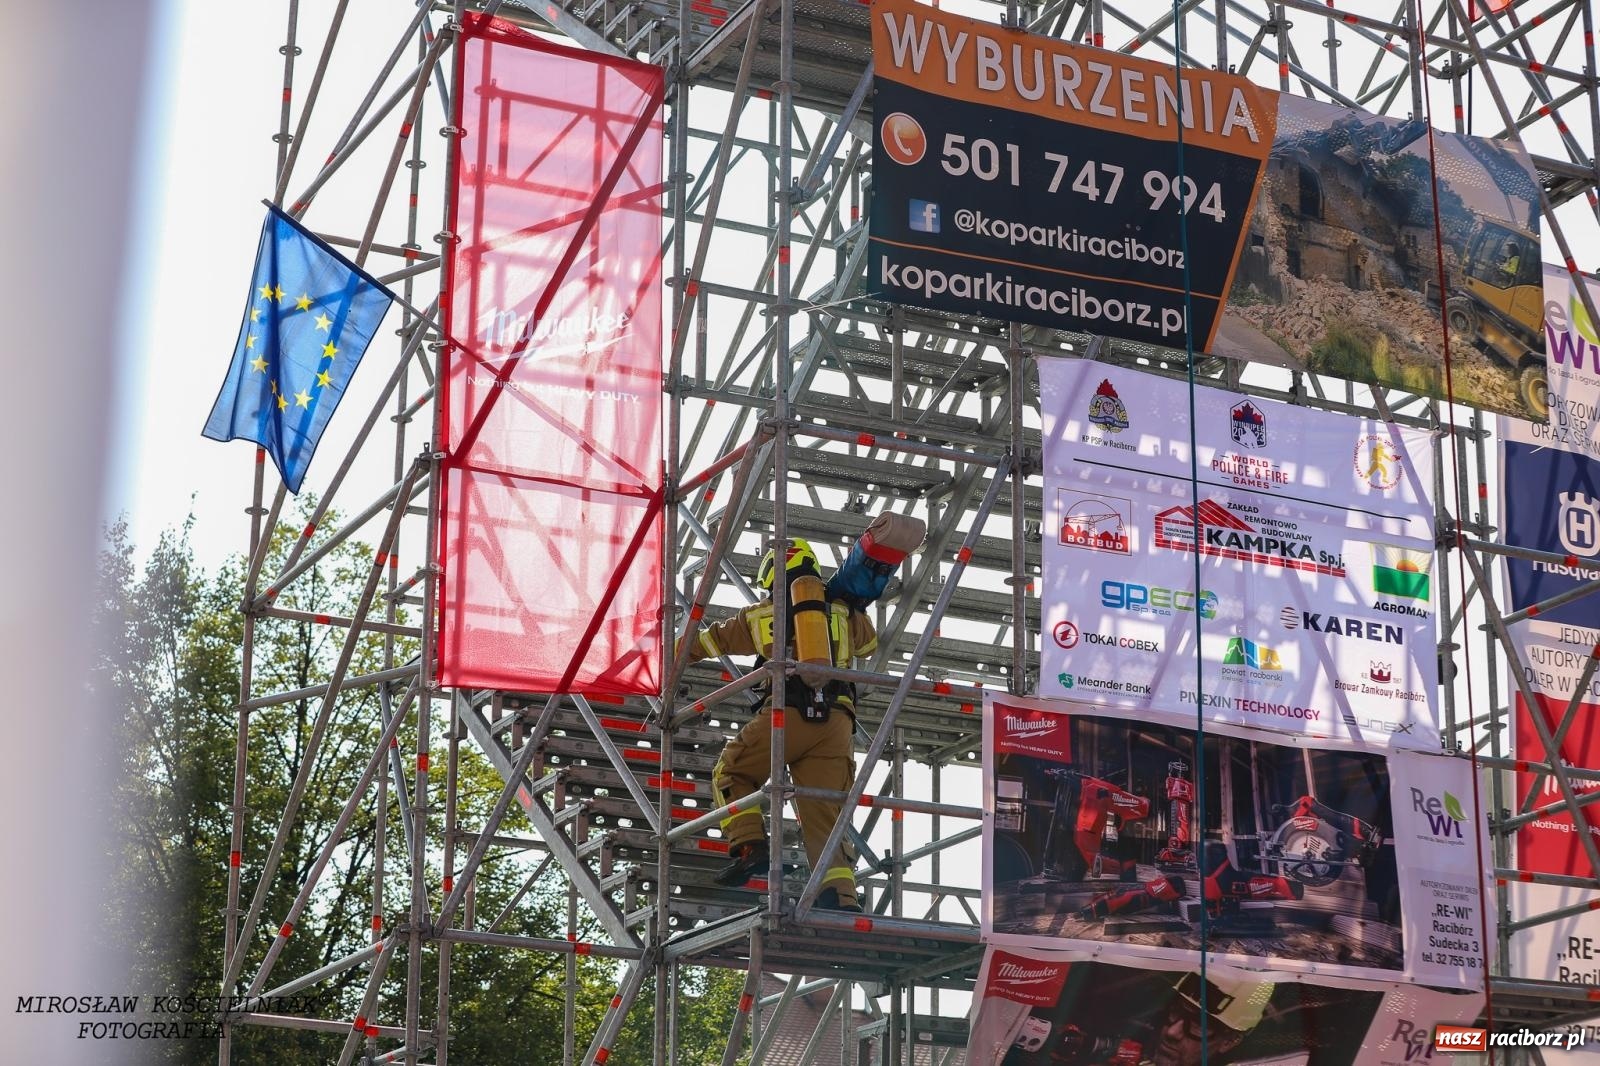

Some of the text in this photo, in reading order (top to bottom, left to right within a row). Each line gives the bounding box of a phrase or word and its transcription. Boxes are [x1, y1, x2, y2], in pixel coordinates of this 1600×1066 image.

[883, 12, 1259, 142] WYBURZENIA
[940, 132, 1226, 223] 501 747 994
[953, 208, 1186, 269] @koparkiraciborz
[881, 255, 1188, 337] koparkiraciborz.pl
[475, 304, 630, 350] Milwaukee
[467, 375, 521, 392] Nothing
[1232, 454, 1269, 468] WORLD
[1212, 459, 1289, 485] POLICE & FIRE
[1233, 476, 1270, 489] GAMES
[1227, 502, 1259, 514] ZAKŁAD
[1244, 515, 1298, 531] REMONTOWO
[1067, 534, 1124, 551] BORBUD
[1206, 527, 1316, 562] KAMPKA
[1261, 527, 1312, 543] BUDOWLANY
[1373, 601, 1429, 620] AGROMAX
[1302, 611, 1403, 645] KAREN
[1083, 632, 1159, 653] TOKAI COBEX
[1077, 676, 1123, 690] Meander
[1125, 683, 1152, 695] Bank
[1334, 679, 1426, 703] Browar Zamkowy Racibórz
[1180, 690, 1321, 721] PIVEXIN TECHNOLOGY
[1003, 714, 1057, 731] Milwaukee
[1409, 786, 1442, 816] Re
[1531, 819, 1569, 832] Nothing
[1433, 919, 1474, 937] Racibórz
[1429, 935, 1479, 952] Sudecka 3
[1422, 951, 1434, 963] tel.
[1436, 952, 1447, 965] 32
[1448, 954, 1465, 967] 755
[1466, 956, 1477, 968] 18
[998, 962, 1058, 978] Milwaukee
